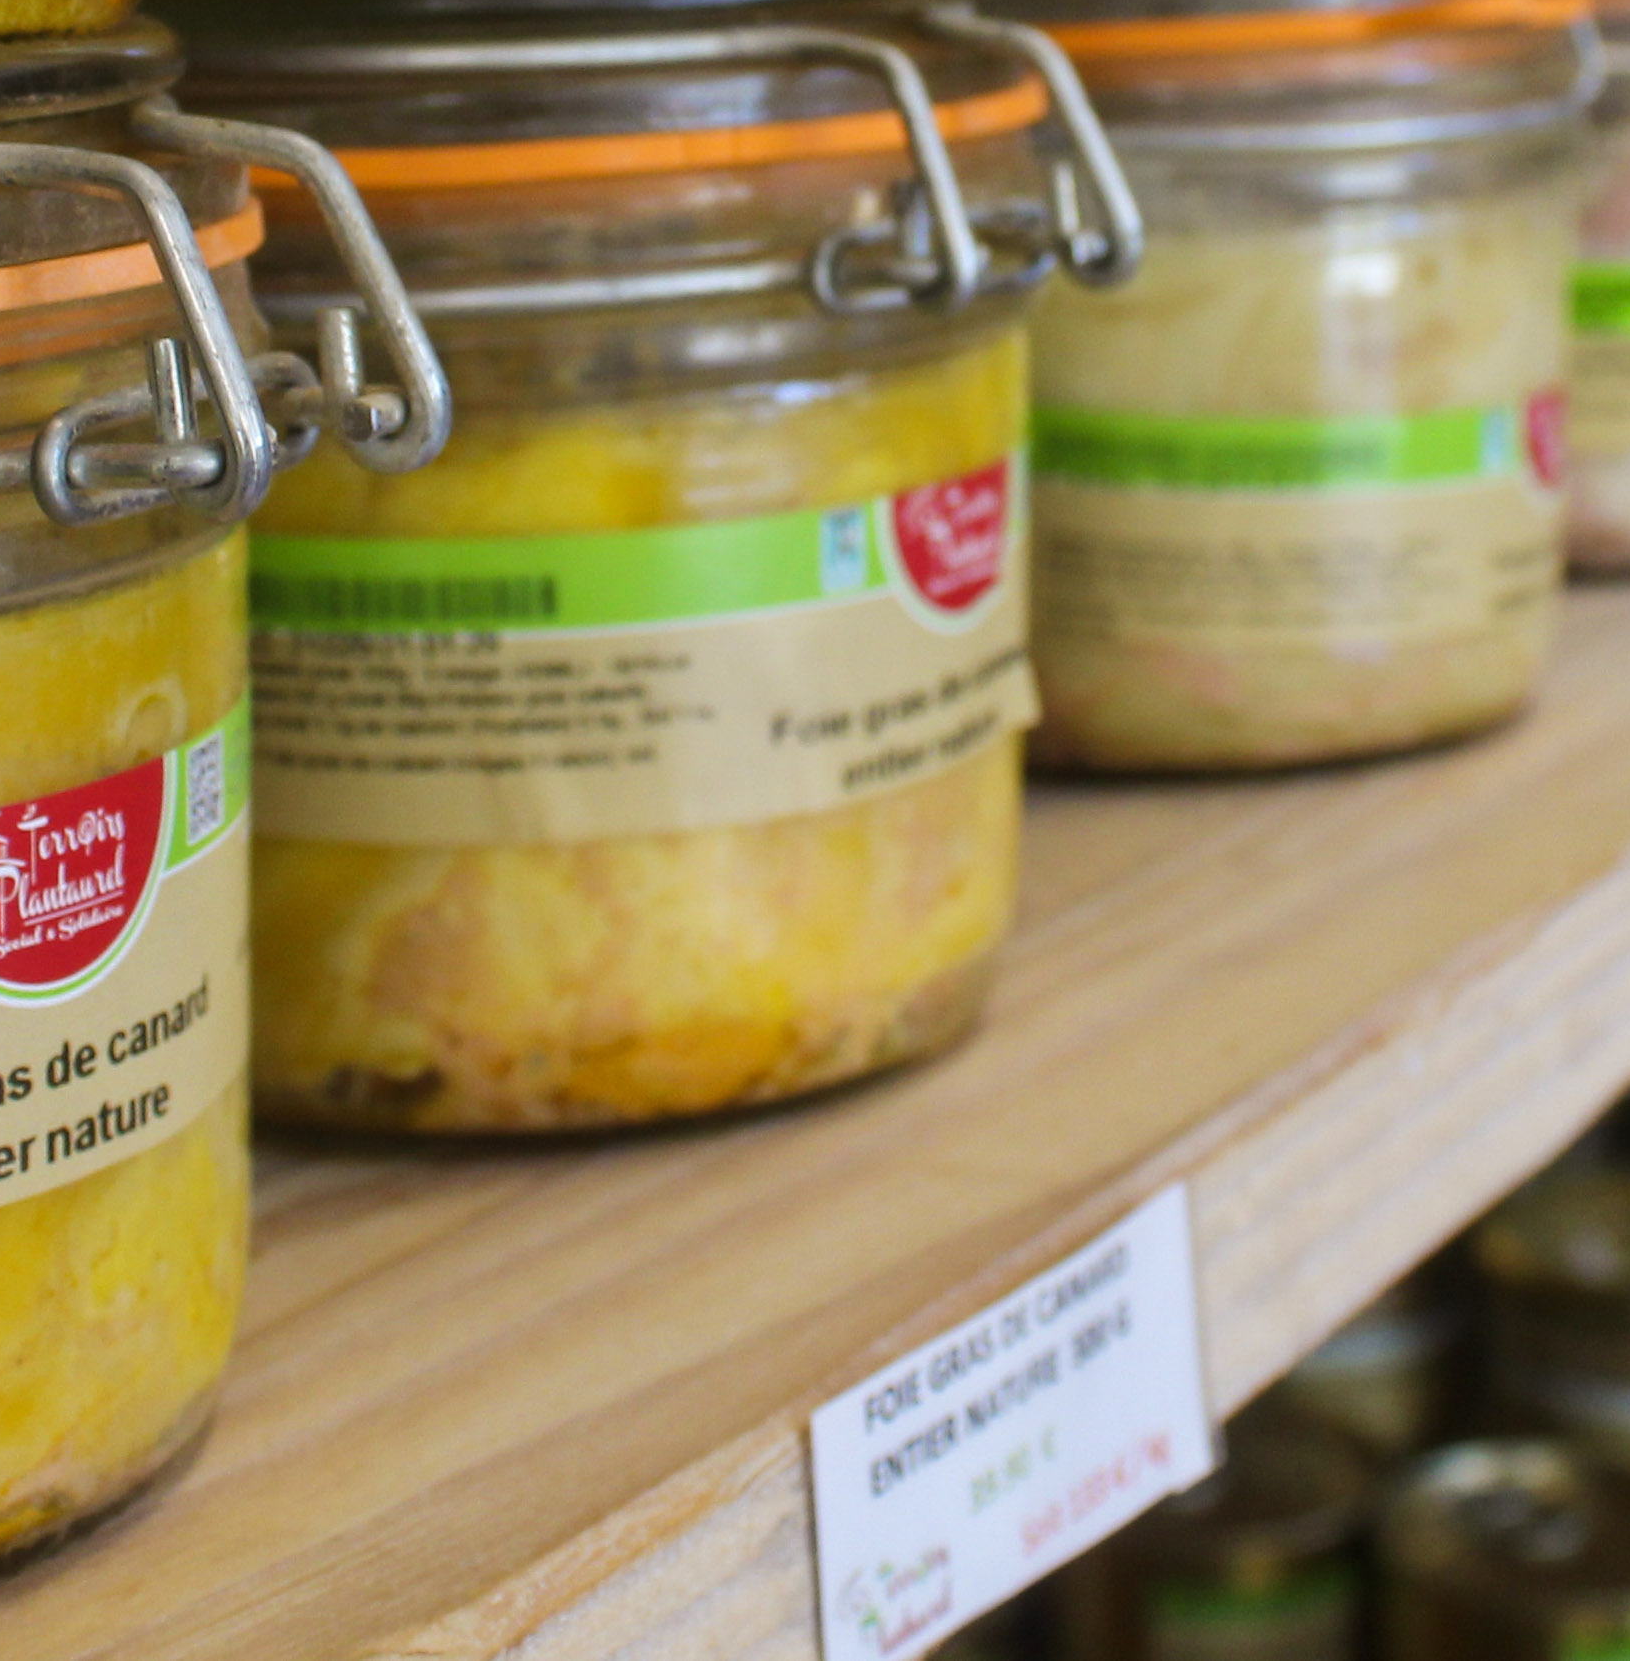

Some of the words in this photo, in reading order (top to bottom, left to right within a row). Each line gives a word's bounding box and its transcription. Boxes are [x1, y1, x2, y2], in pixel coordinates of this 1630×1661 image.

[17, 806, 126, 886] Terroirs
[45, 1041, 97, 1090] de
[107, 973, 210, 1066] canard
[46, 1082, 171, 1164] nature
